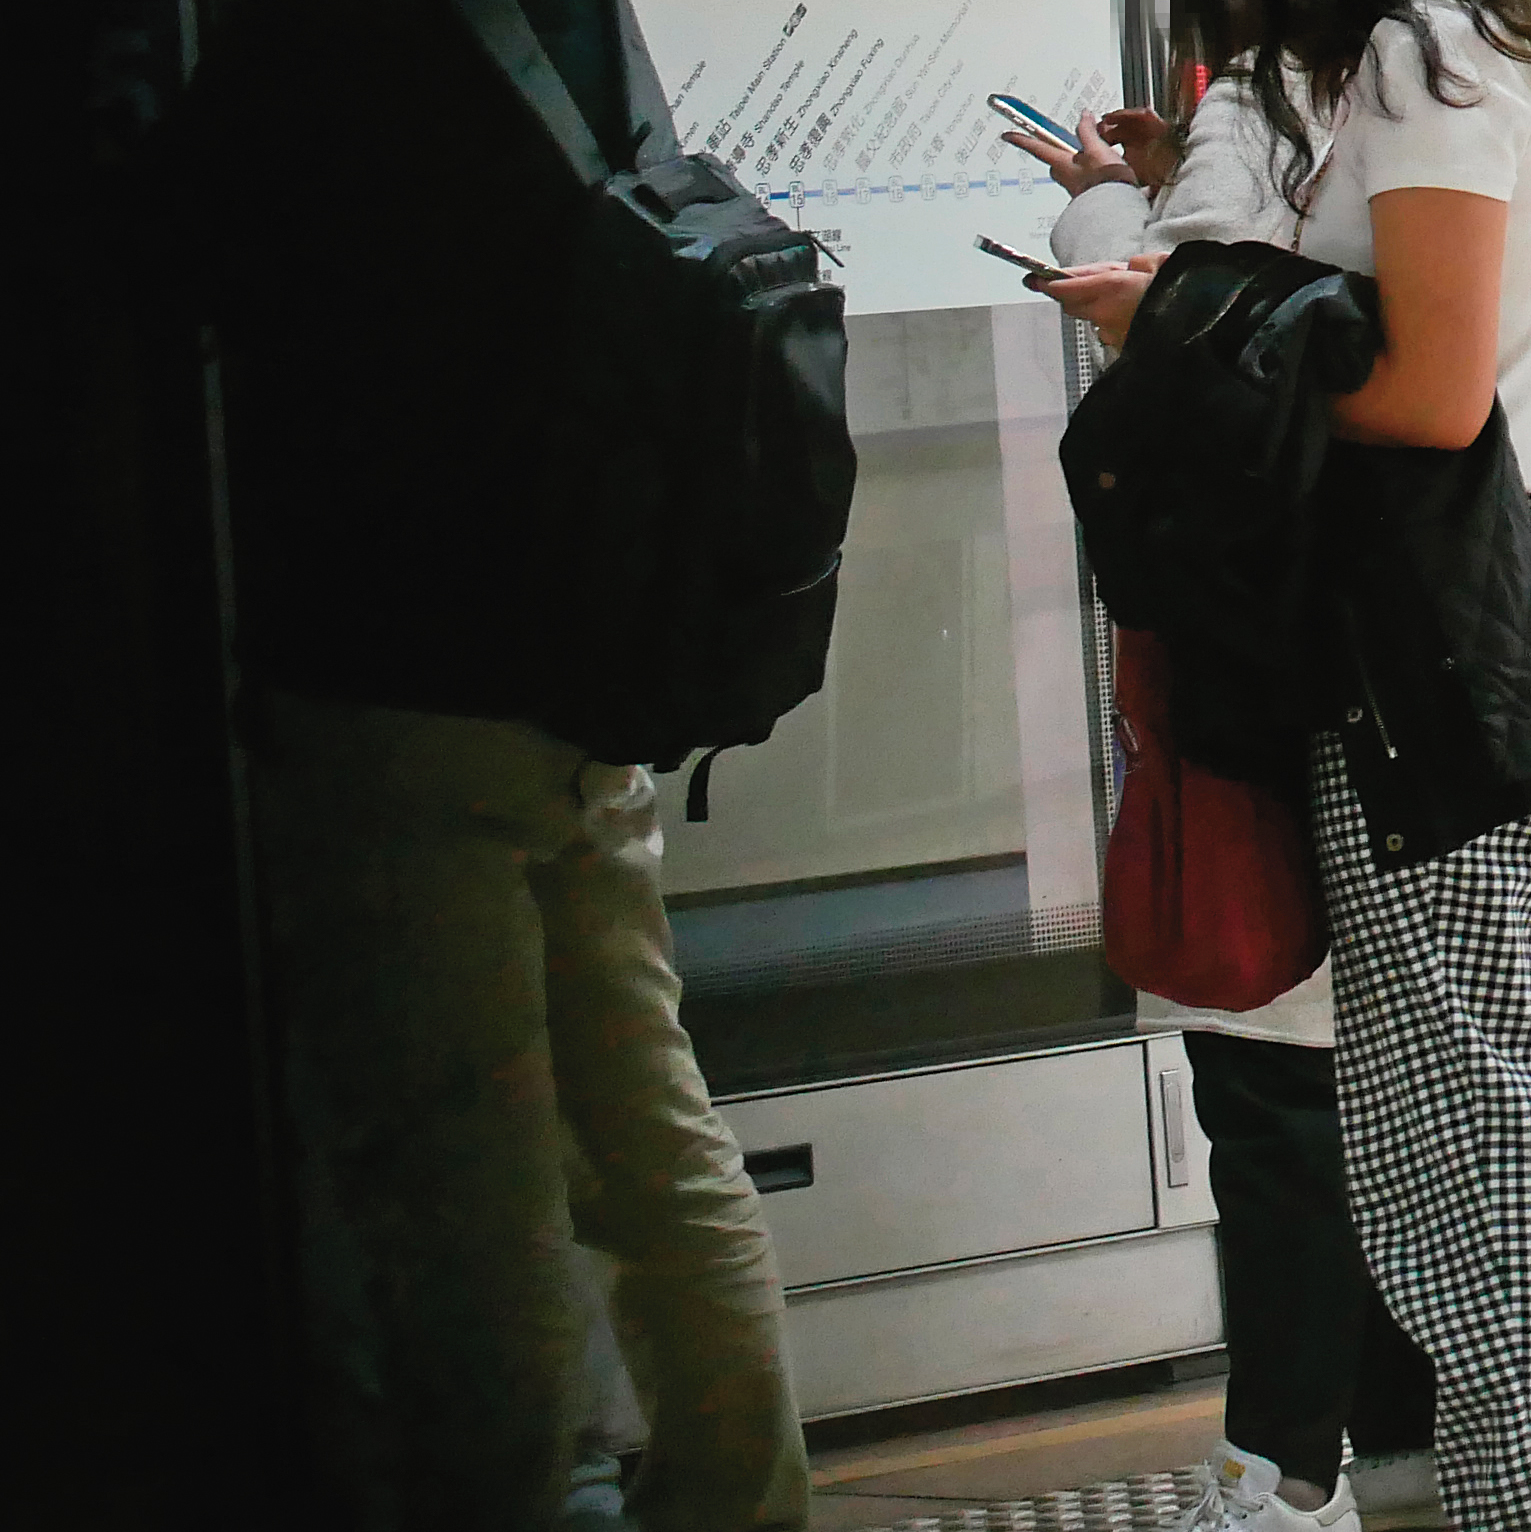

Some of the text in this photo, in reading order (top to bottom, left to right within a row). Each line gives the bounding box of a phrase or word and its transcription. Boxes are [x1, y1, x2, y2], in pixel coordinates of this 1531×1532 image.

[729, 92, 749, 120] Taipei
[747, 71, 765, 94] Main
[763, 38, 786, 70] Station
[861, 38, 884, 69] Fuxing
